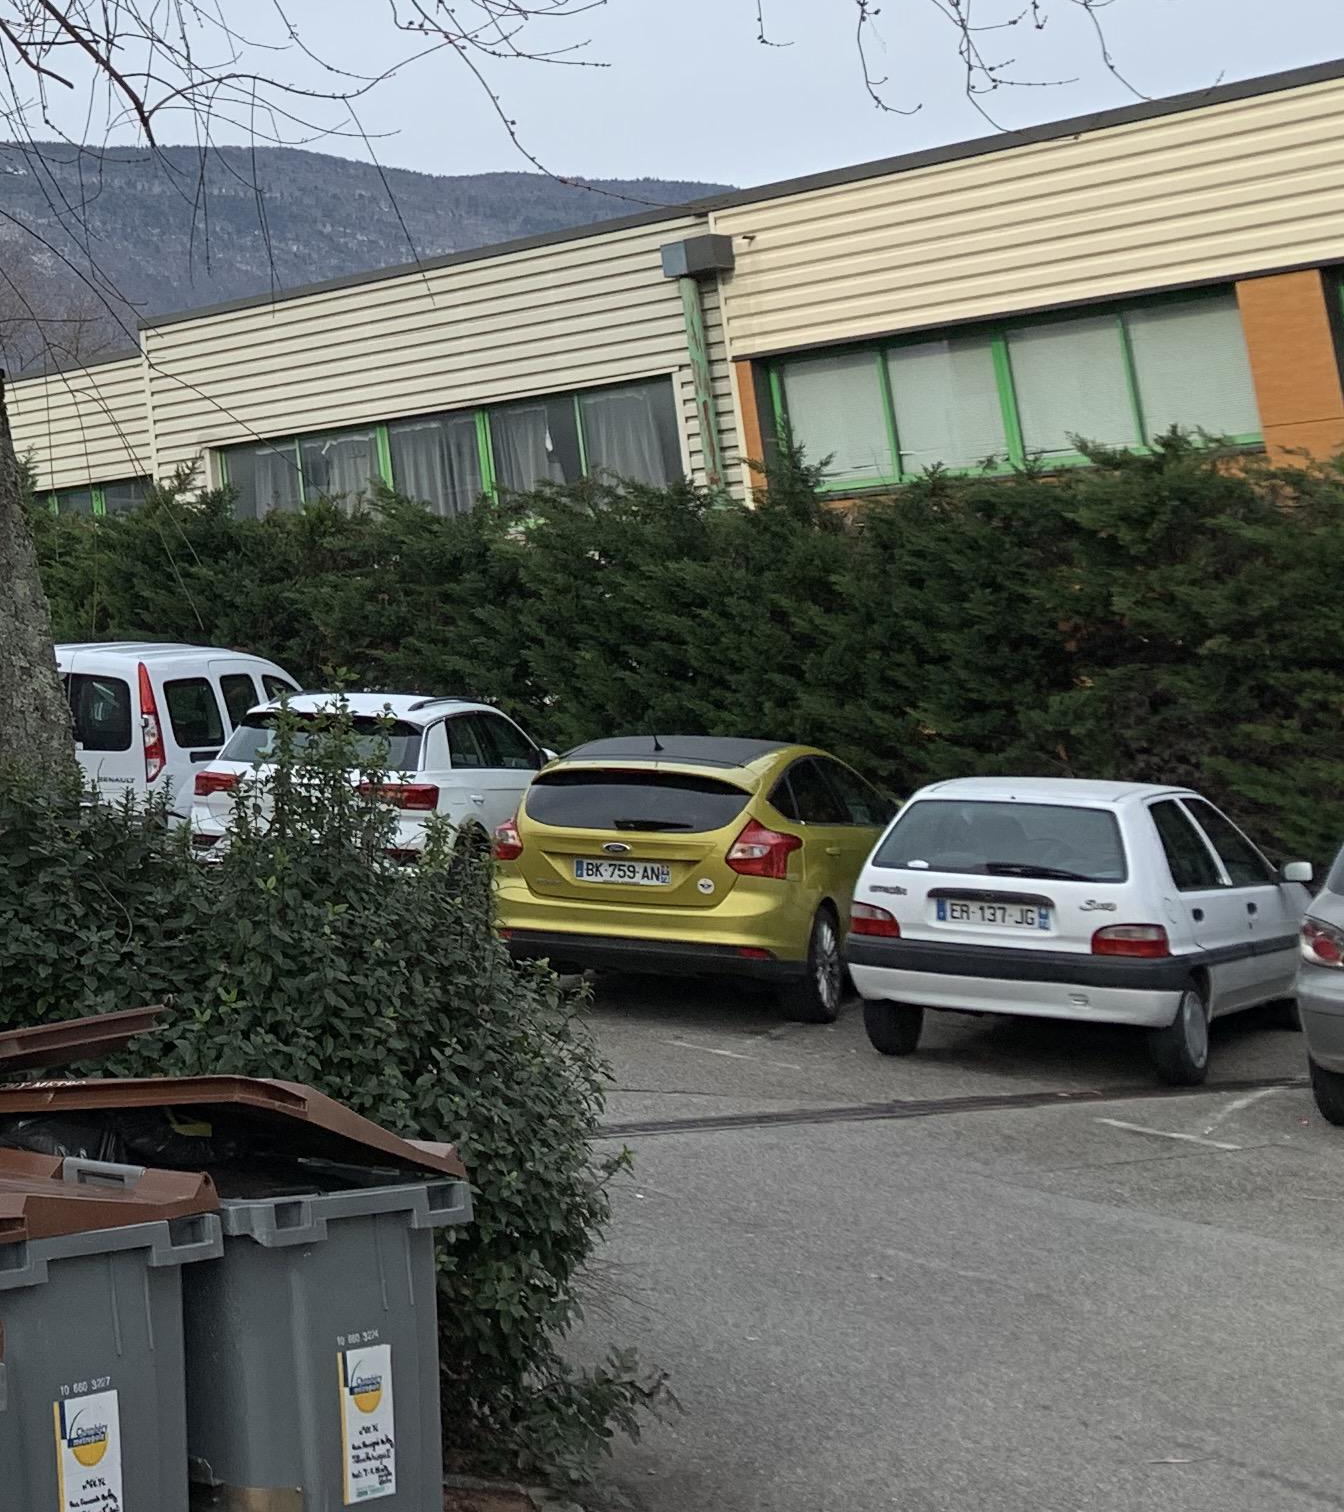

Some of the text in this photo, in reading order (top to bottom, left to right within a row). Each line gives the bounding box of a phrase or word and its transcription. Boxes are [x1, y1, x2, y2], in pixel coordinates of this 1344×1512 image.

[585, 861, 660, 881] BK-759-AN
[950, 902, 1035, 926] ER-137-JG
[60, 1385, 70, 1396] 10
